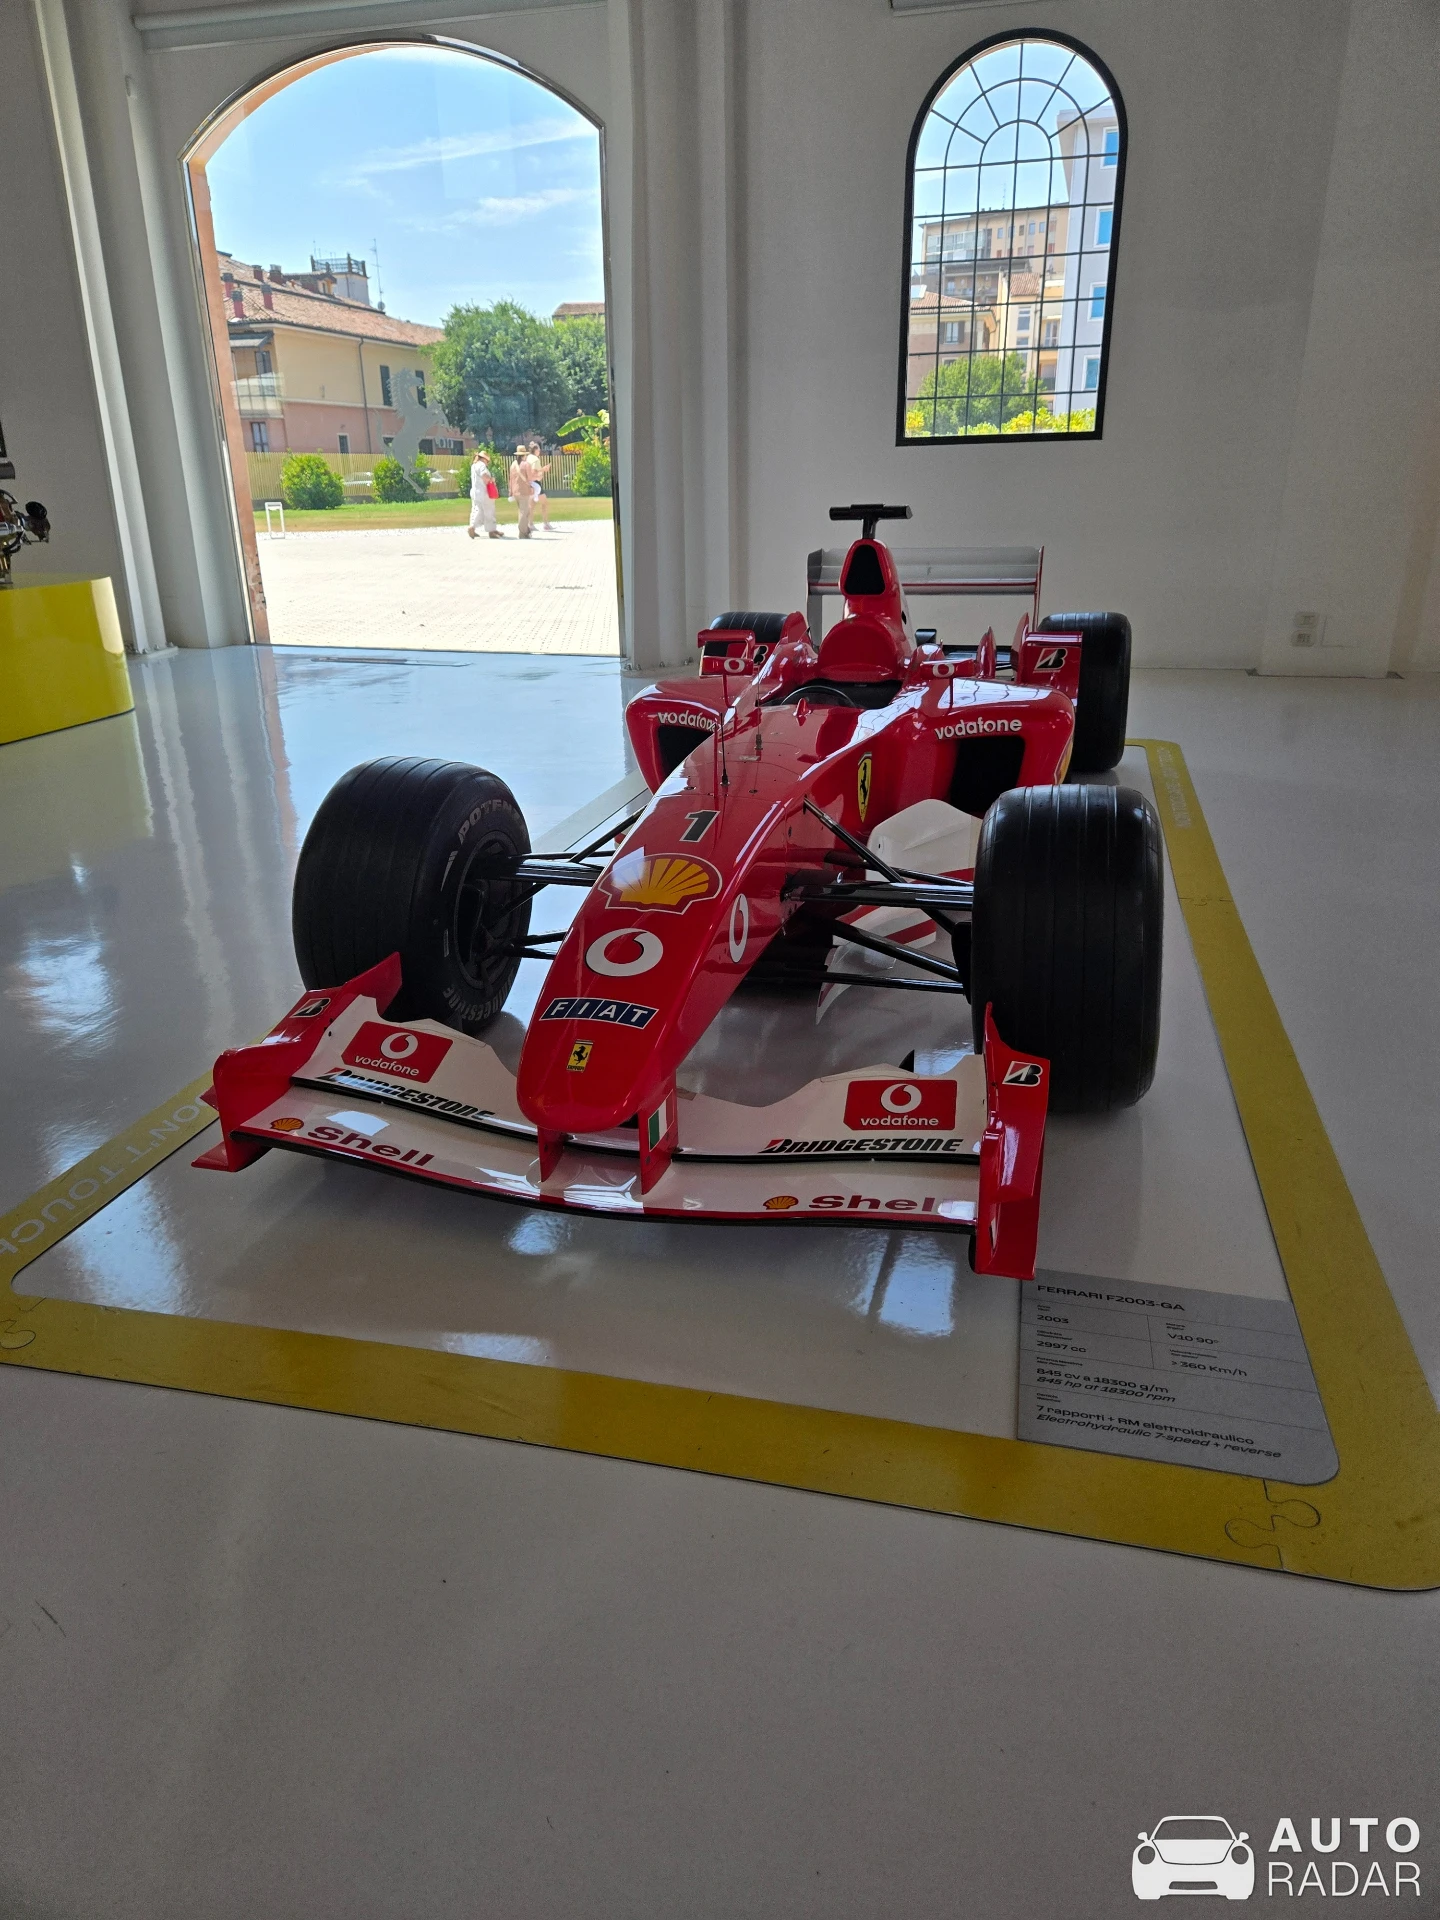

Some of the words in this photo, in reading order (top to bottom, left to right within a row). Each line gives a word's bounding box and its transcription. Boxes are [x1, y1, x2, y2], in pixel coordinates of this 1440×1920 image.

[935, 716, 1022, 740] vodafone
[679, 809, 720, 842] 1
[549, 1001, 649, 1024] FIAT
[355, 1053, 420, 1077] vodafone
[860, 1115, 939, 1127] vodafone
[307, 1126, 435, 1167] Shell
[758, 1138, 964, 1153] BRIDGESTONE
[808, 1194, 942, 1213] Shel
[1037, 1284, 1103, 1300] FERRARI
[1106, 1294, 1185, 1311] F2003-GA
[1037, 1314, 1069, 1324] 2003
[1036, 1340, 1069, 1350] 2997
[1167, 1333, 1194, 1342] V10
[1180, 1361, 1207, 1370] 360
[1036, 1368, 1062, 1377] 845
[1093, 1377, 1137, 1389] 18300
[1139, 1384, 1169, 1394] g/m
[1036, 1376, 1063, 1385] 845
[1064, 1380, 1082, 1389] hp
[1100, 1386, 1145, 1398] 18300
[1146, 1393, 1176, 1403] rpm
[1036, 1404, 1045, 1412] 7
[1047, 1407, 1105, 1421] rapporti
[1117, 1417, 1140, 1427] RM
[1142, 1422, 1255, 1445] elettroidraulico
[1036, 1413, 1152, 1438] Electrohydraulic
[1154, 1432, 1211, 1447] 7-speed
[1223, 1443, 1281, 1458] reverse
